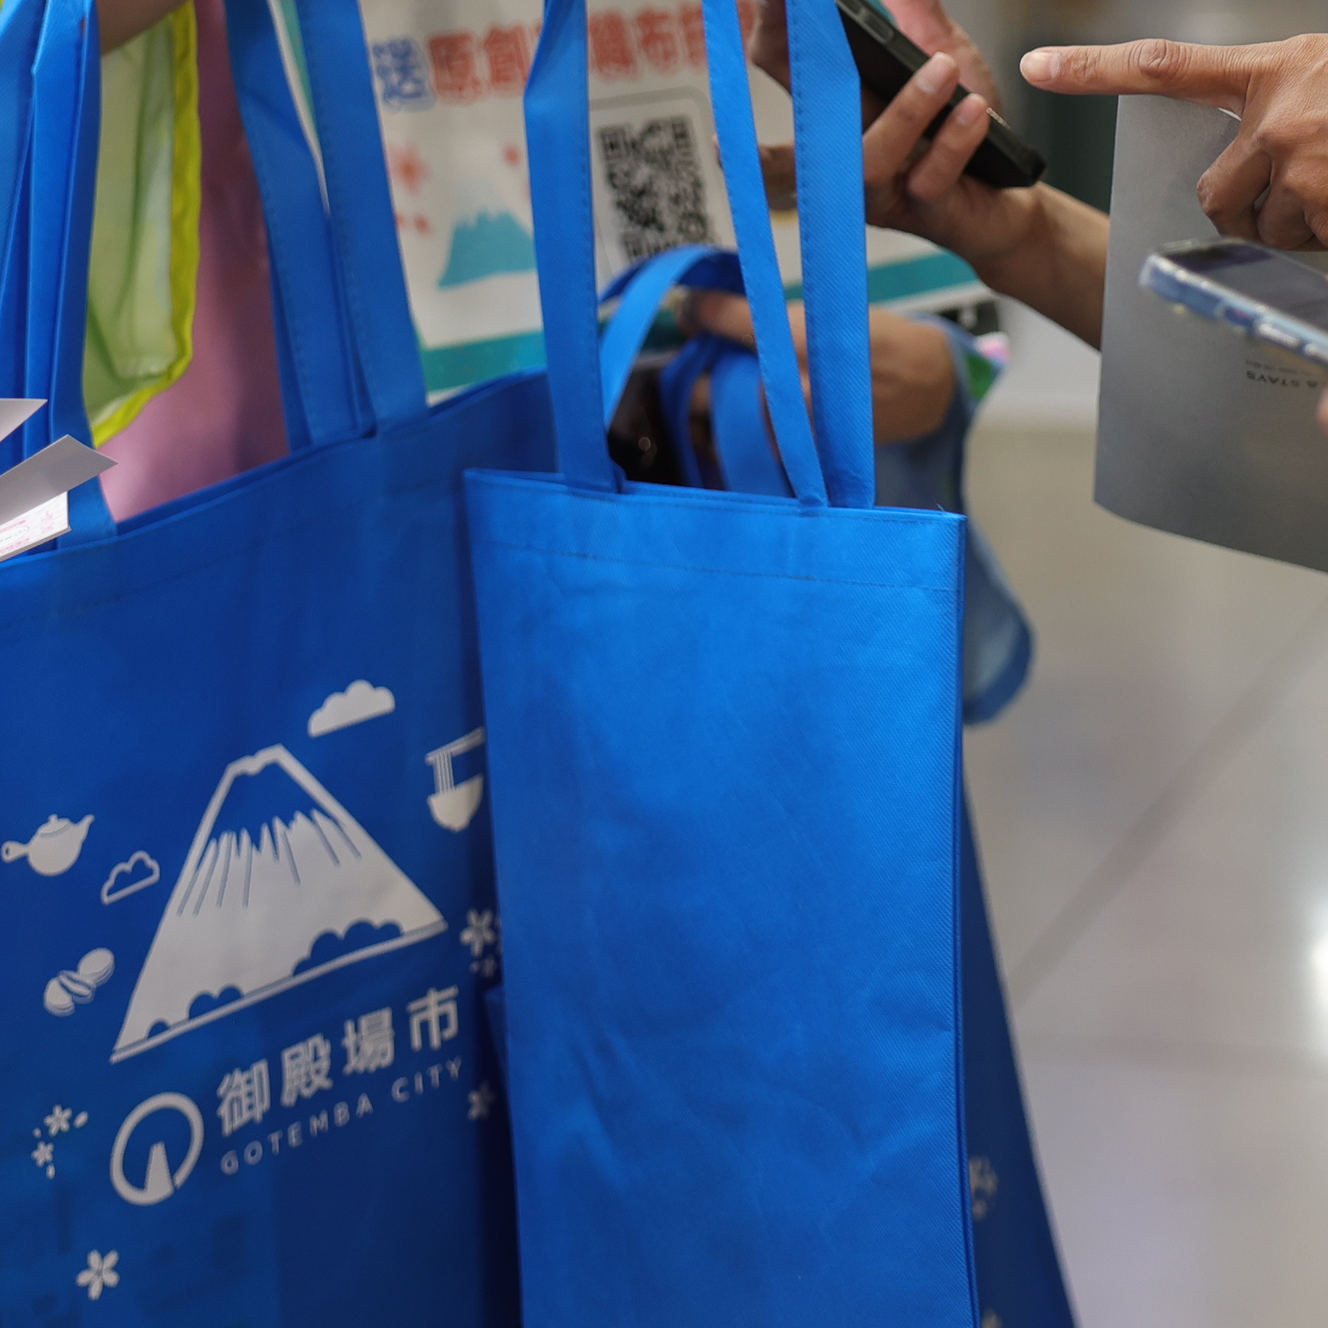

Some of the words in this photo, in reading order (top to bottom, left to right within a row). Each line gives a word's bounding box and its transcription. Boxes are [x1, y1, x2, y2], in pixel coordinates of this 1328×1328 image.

[215, 984, 460, 1139] 御殿場市
[220, 1092, 374, 1176] GOTEMBA
[390, 1055, 463, 1103] CITY
